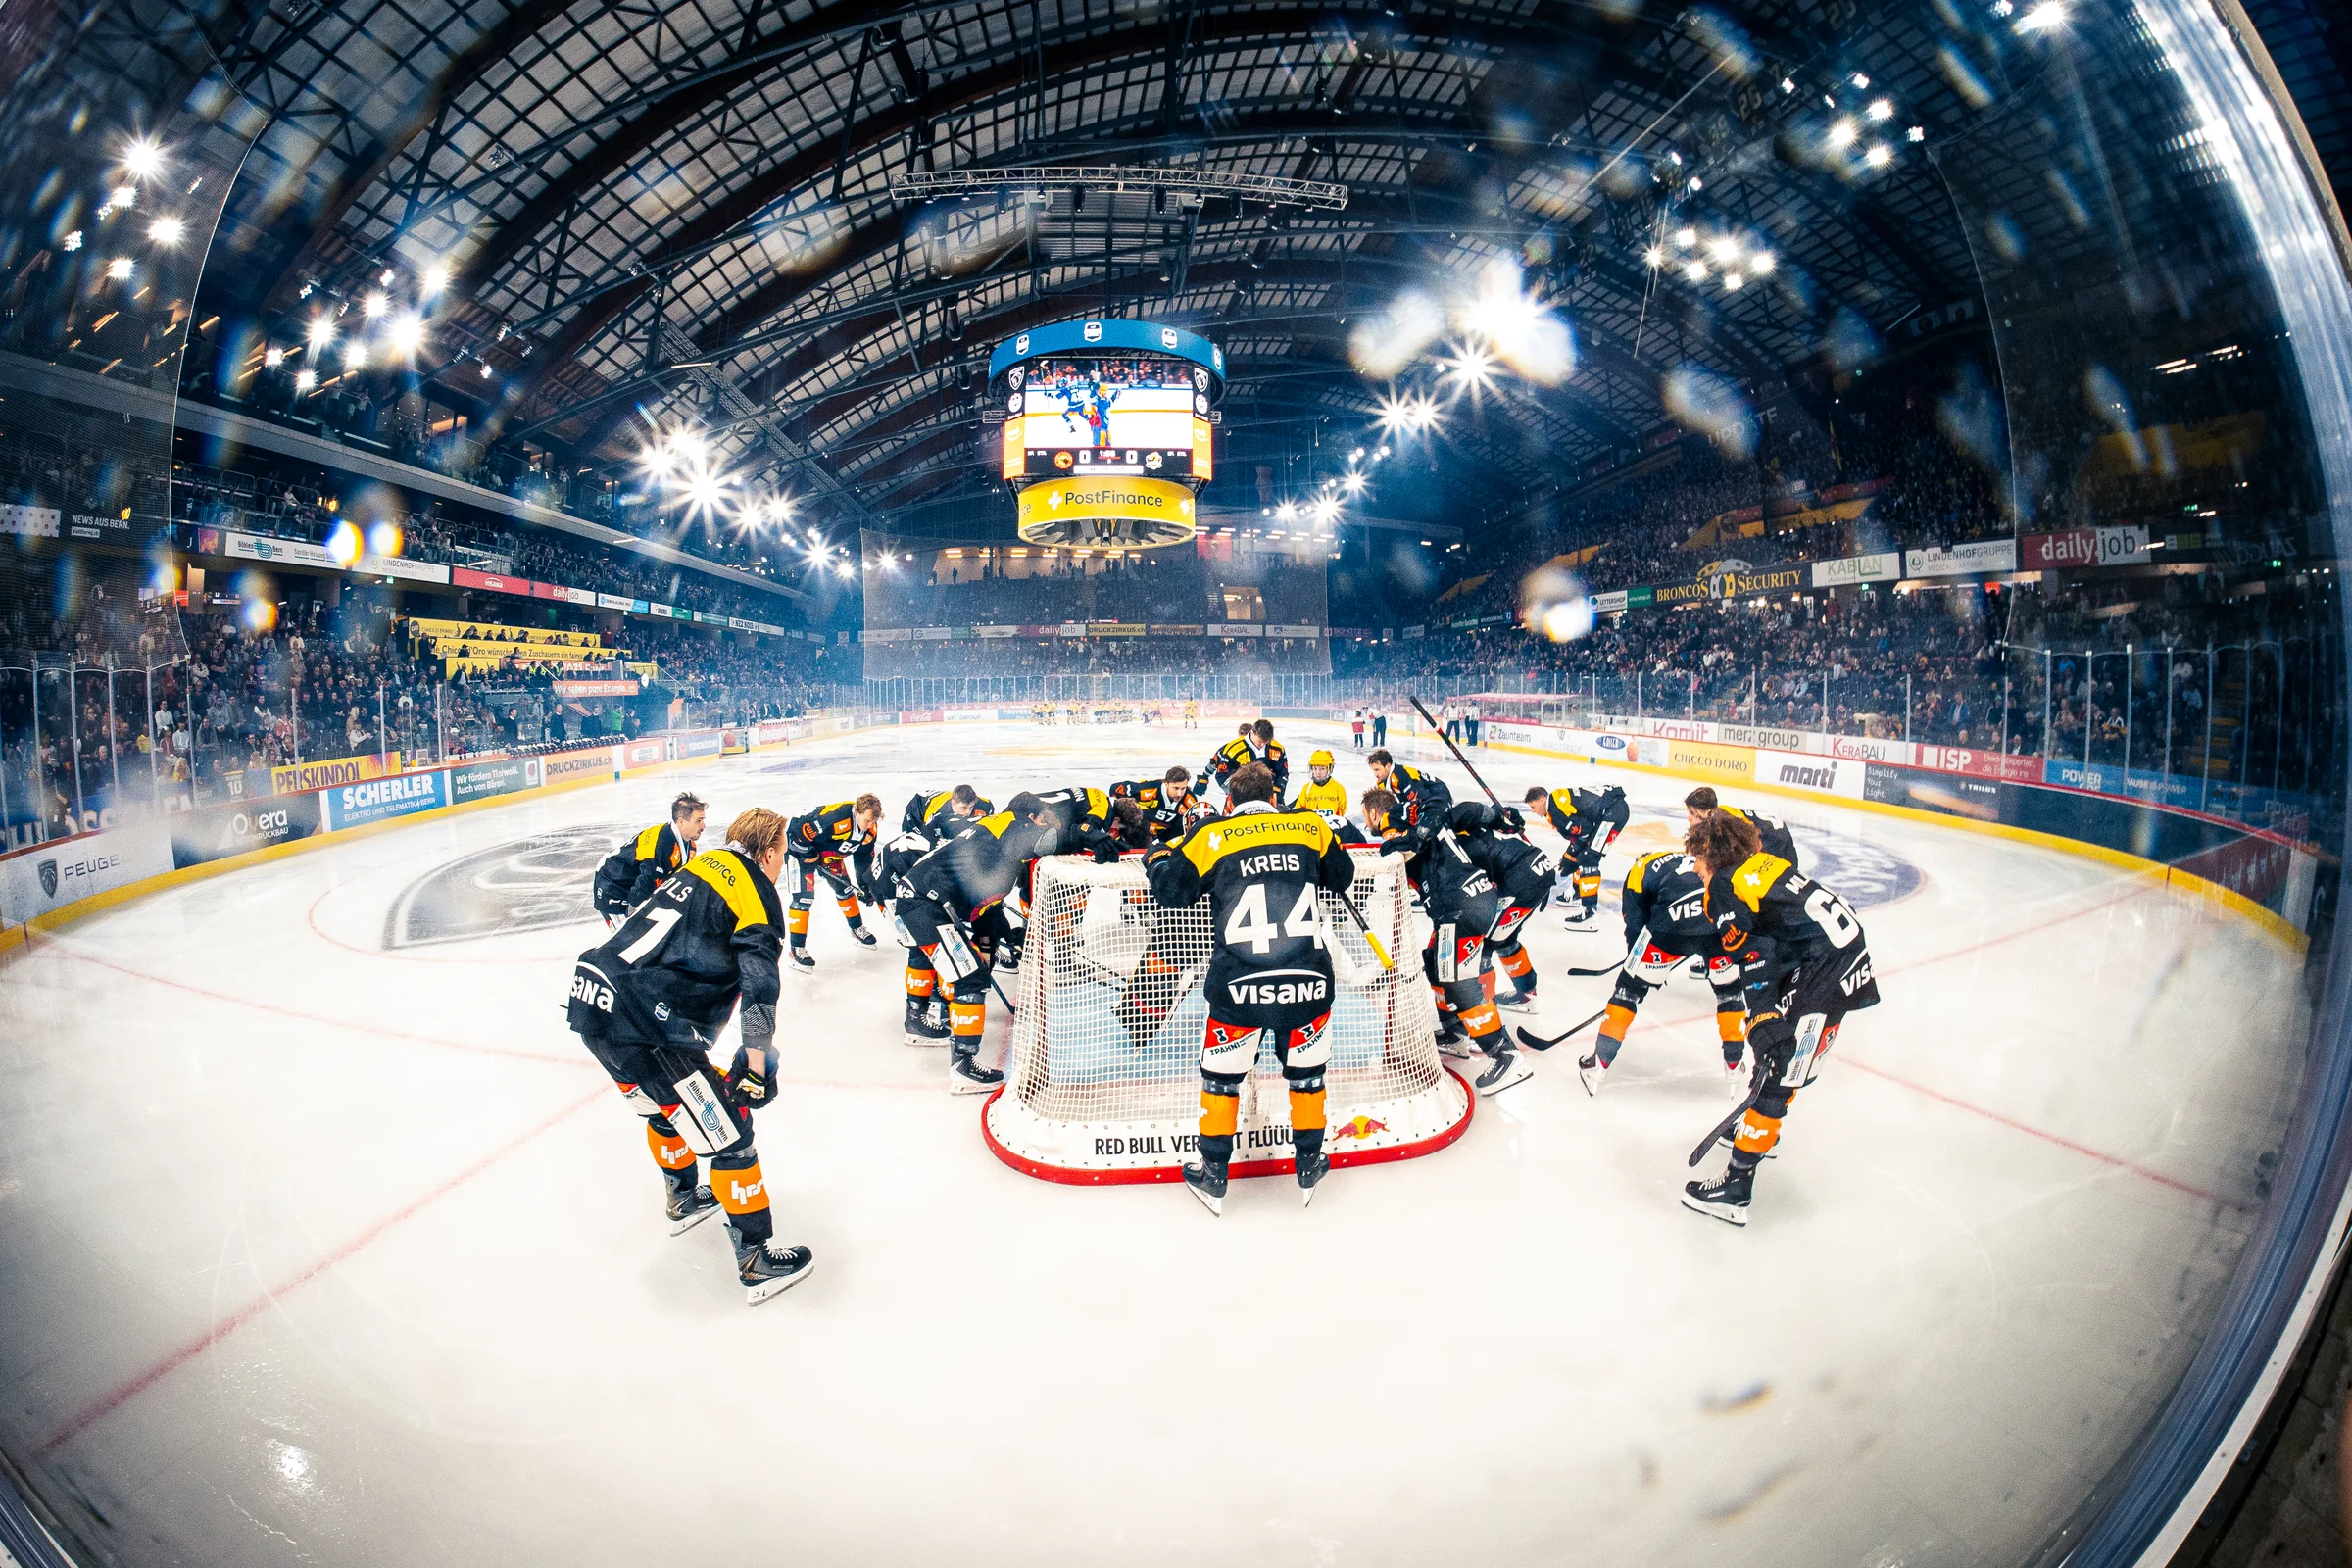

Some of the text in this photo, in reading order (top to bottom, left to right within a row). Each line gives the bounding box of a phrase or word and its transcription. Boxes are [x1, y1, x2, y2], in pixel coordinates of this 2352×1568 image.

[1065, 490, 1163, 507] PostFinance
[72, 514, 130, 529] NEWS AUS BERN.
[237, 540, 254, 549] Böhlen
[1927, 544, 2013, 563] LINDENHOFGRUPPE
[2041, 529, 2136, 564] daily.job
[382, 559, 435, 573] LINDENHOFGRUPPE
[553, 586, 579, 601] daily.job
[1656, 570, 1802, 602] BRONCOS SECURITY
[1039, 625, 1076, 636] daily.job
[487, 647, 512, 656] wünsch
[529, 649, 561, 659] Zuschauern
[569, 651, 583, 660] faires
[1497, 728, 1531, 743] Zaunteam
[1758, 730, 1799, 750] group
[1833, 737, 1886, 761] KERABAU
[546, 756, 612, 776] DRUCKZIRKUS.ch
[1674, 753, 1712, 767] CHICCO
[1940, 748, 1972, 771] ISP
[455, 774, 467, 785] Wir
[467, 770, 491, 782] fördern
[1779, 761, 1838, 789] marti
[1867, 766, 1898, 780] Simplify
[2062, 769, 2102, 785] POWER
[343, 775, 434, 810] SCHERLER
[456, 784, 474, 795] Auch
[474, 783, 487, 792] von
[344, 797, 436, 821] ELEKTRO UND TELEMATIK BERN
[1155, 809, 1177, 822] 57
[1223, 821, 1318, 841] PostFinance
[838, 841, 860, 853] 64
[64, 853, 122, 881] PEUGE
[1240, 853, 1300, 878] KREIS
[1224, 882, 1325, 955] 44
[951, 1009, 980, 1029] hrs
[688, 1080, 729, 1142] Böhlen Bern
[1095, 1138, 1125, 1155] RED
[1130, 1136, 1166, 1154] BULL
[1171, 1131, 1243, 1152] VERT
[661, 1144, 689, 1164] hrs
[731, 1178, 764, 1205] hrs
